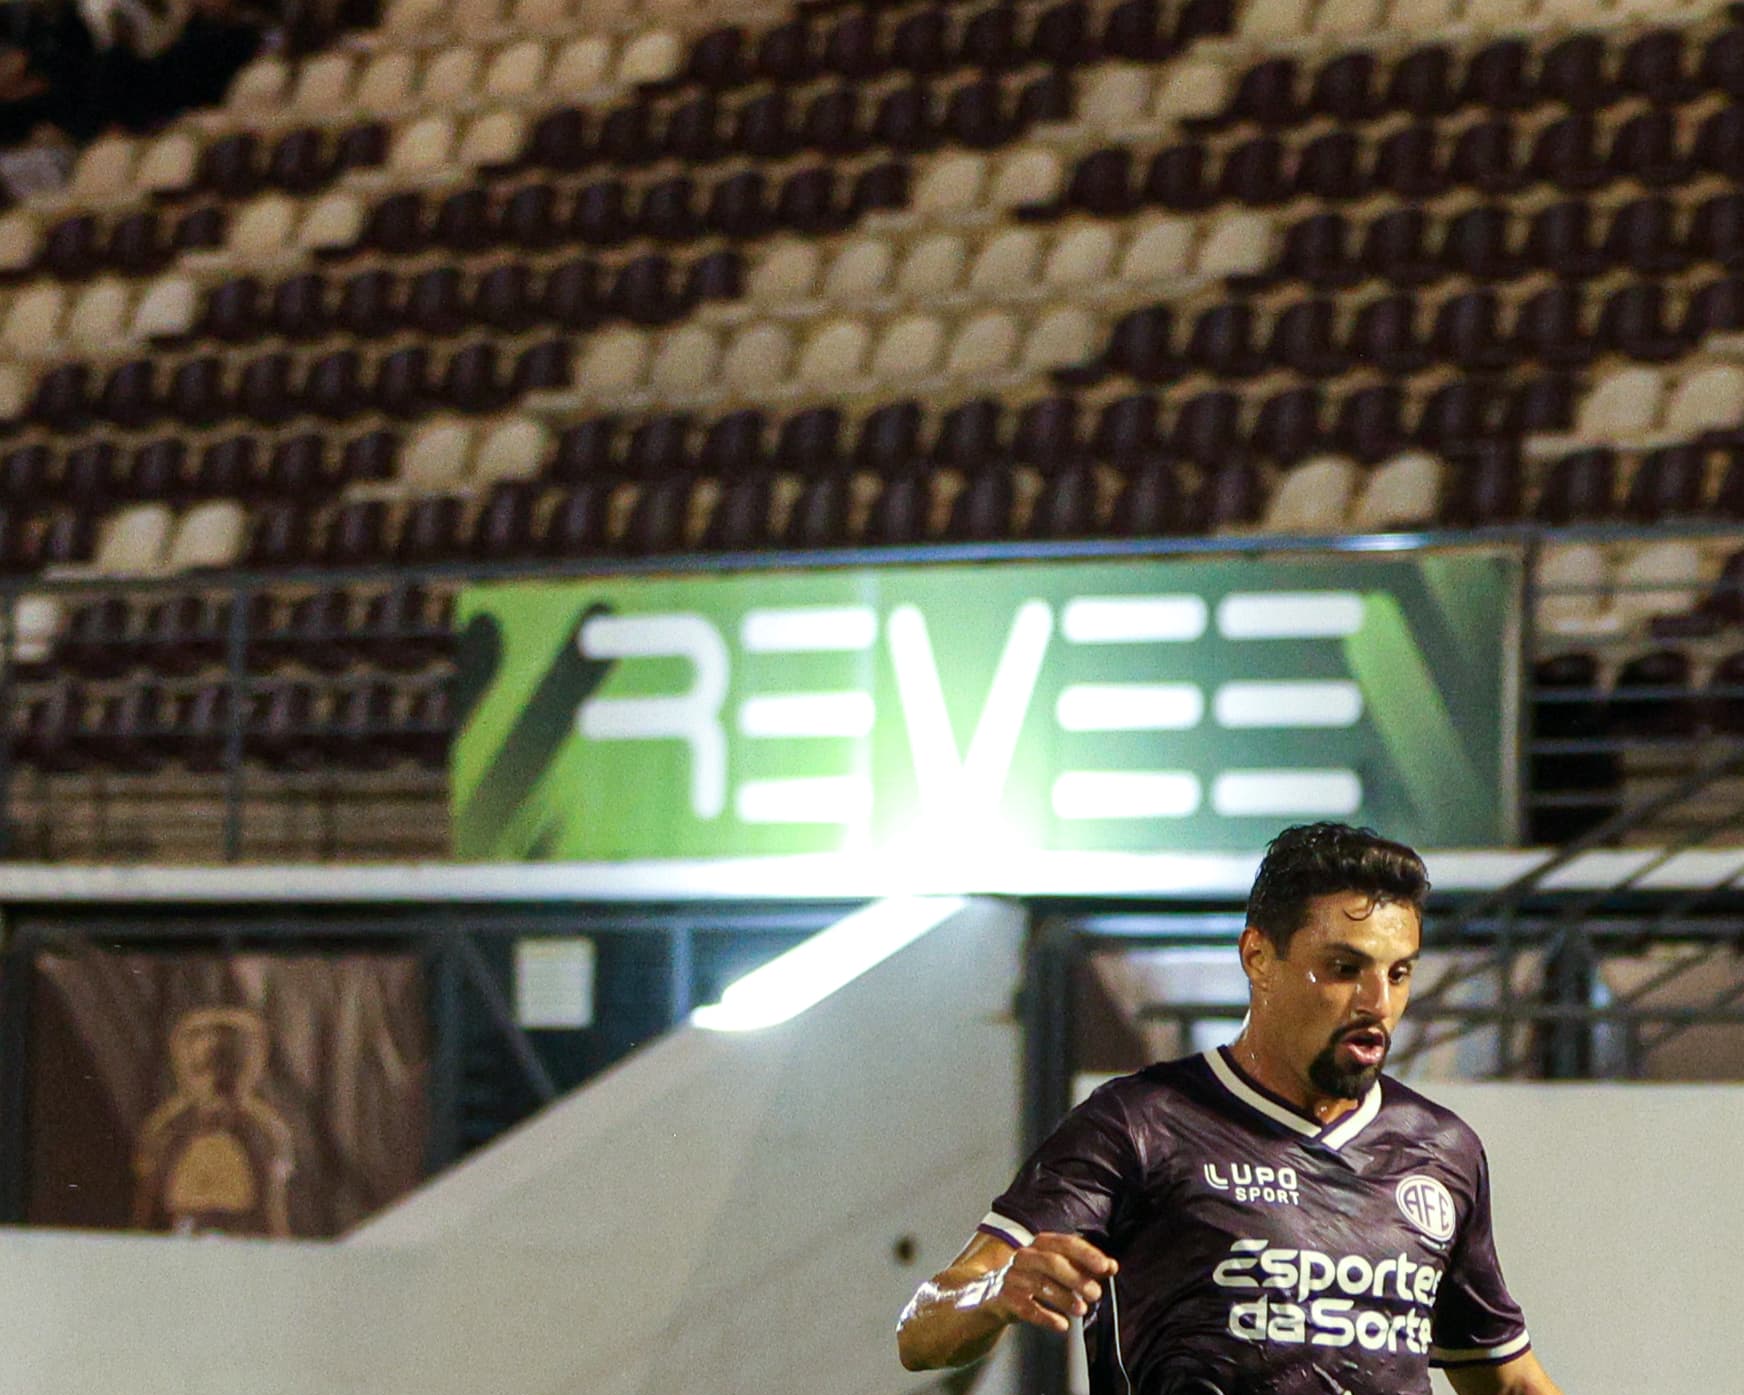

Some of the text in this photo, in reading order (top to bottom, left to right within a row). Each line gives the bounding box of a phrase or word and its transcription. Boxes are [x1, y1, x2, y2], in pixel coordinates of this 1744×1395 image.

[1203, 1163, 1297, 1190] LUPO
[1235, 1186, 1300, 1206] SPORT
[1402, 1183, 1450, 1232] AFE
